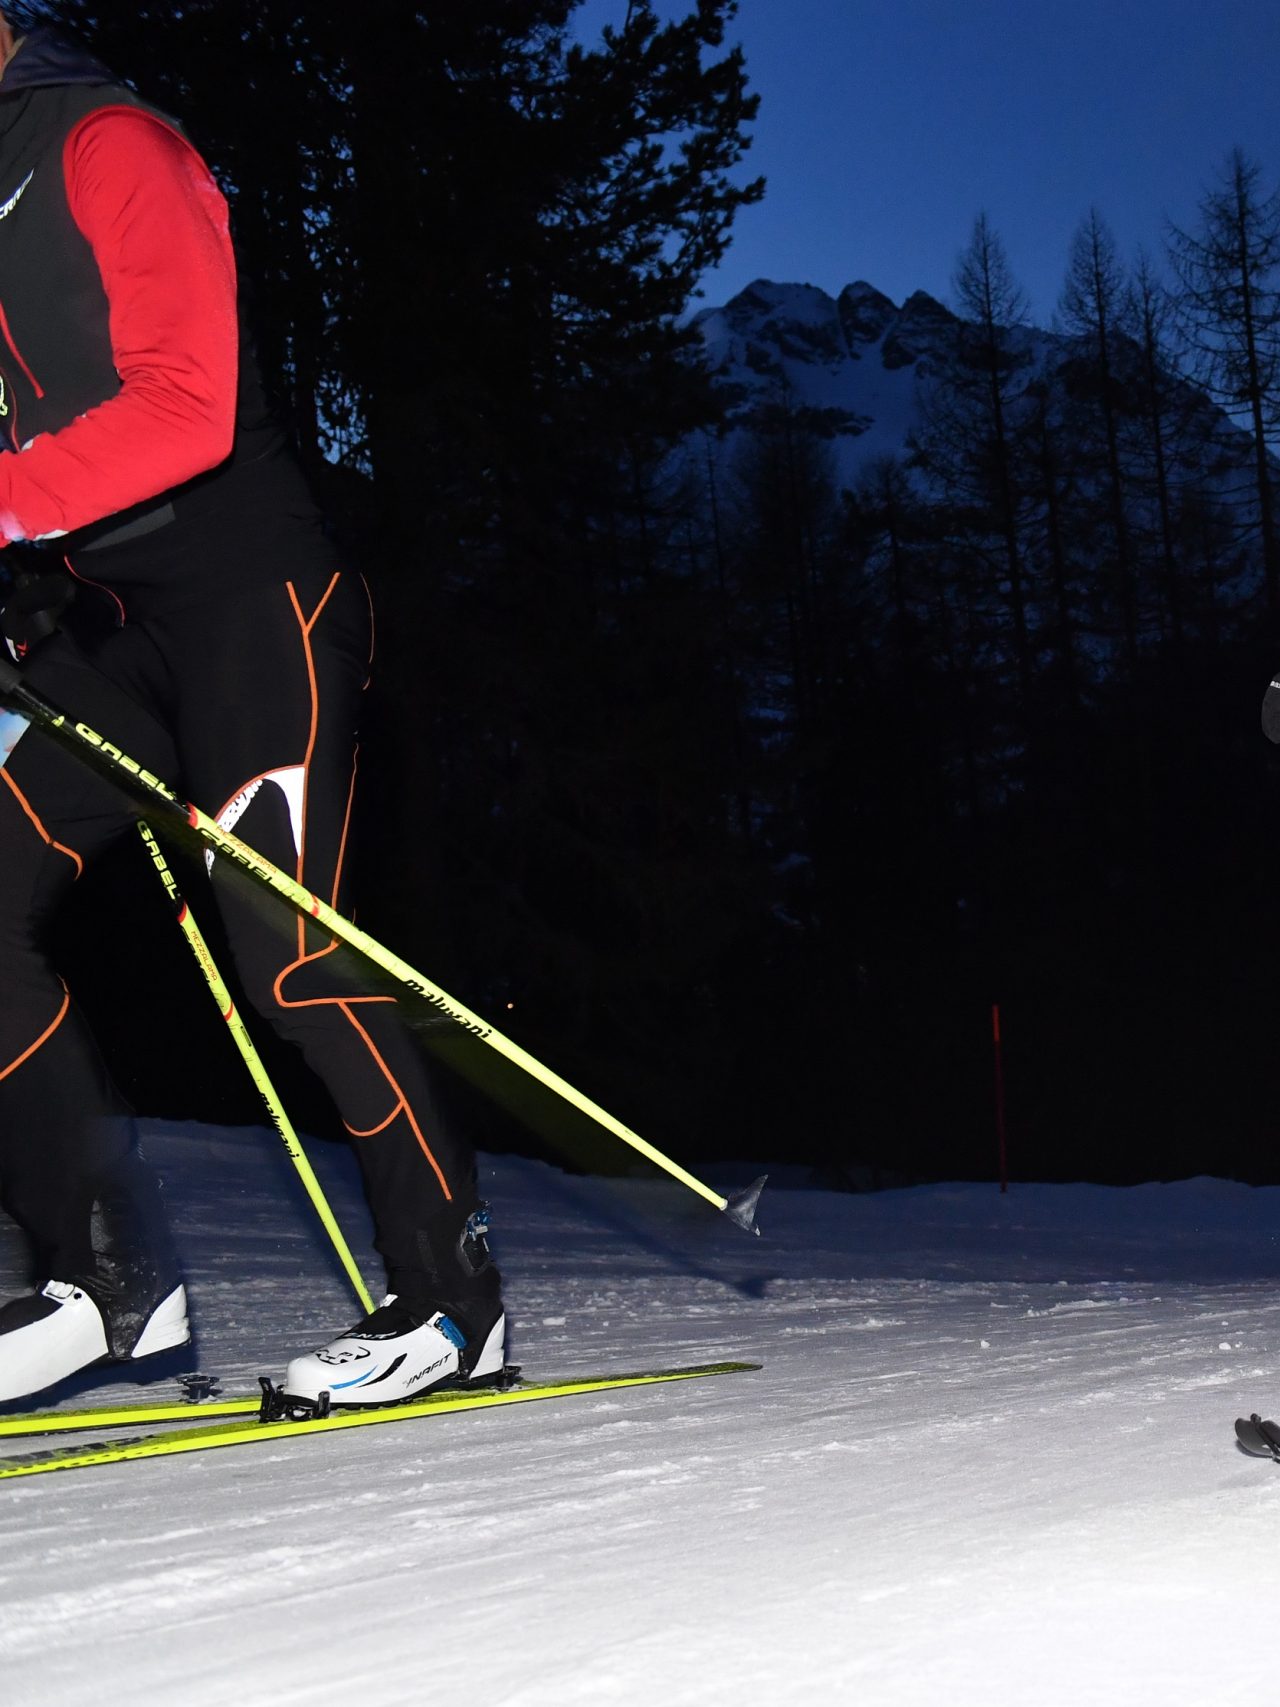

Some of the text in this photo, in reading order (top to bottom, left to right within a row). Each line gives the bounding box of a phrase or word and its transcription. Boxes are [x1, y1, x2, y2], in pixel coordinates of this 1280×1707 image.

[75, 722, 173, 801] GABEL
[136, 820, 178, 900] GABEL
[215, 824, 278, 875] MEZZALAMA
[190, 930, 218, 982] MEZZALAMA
